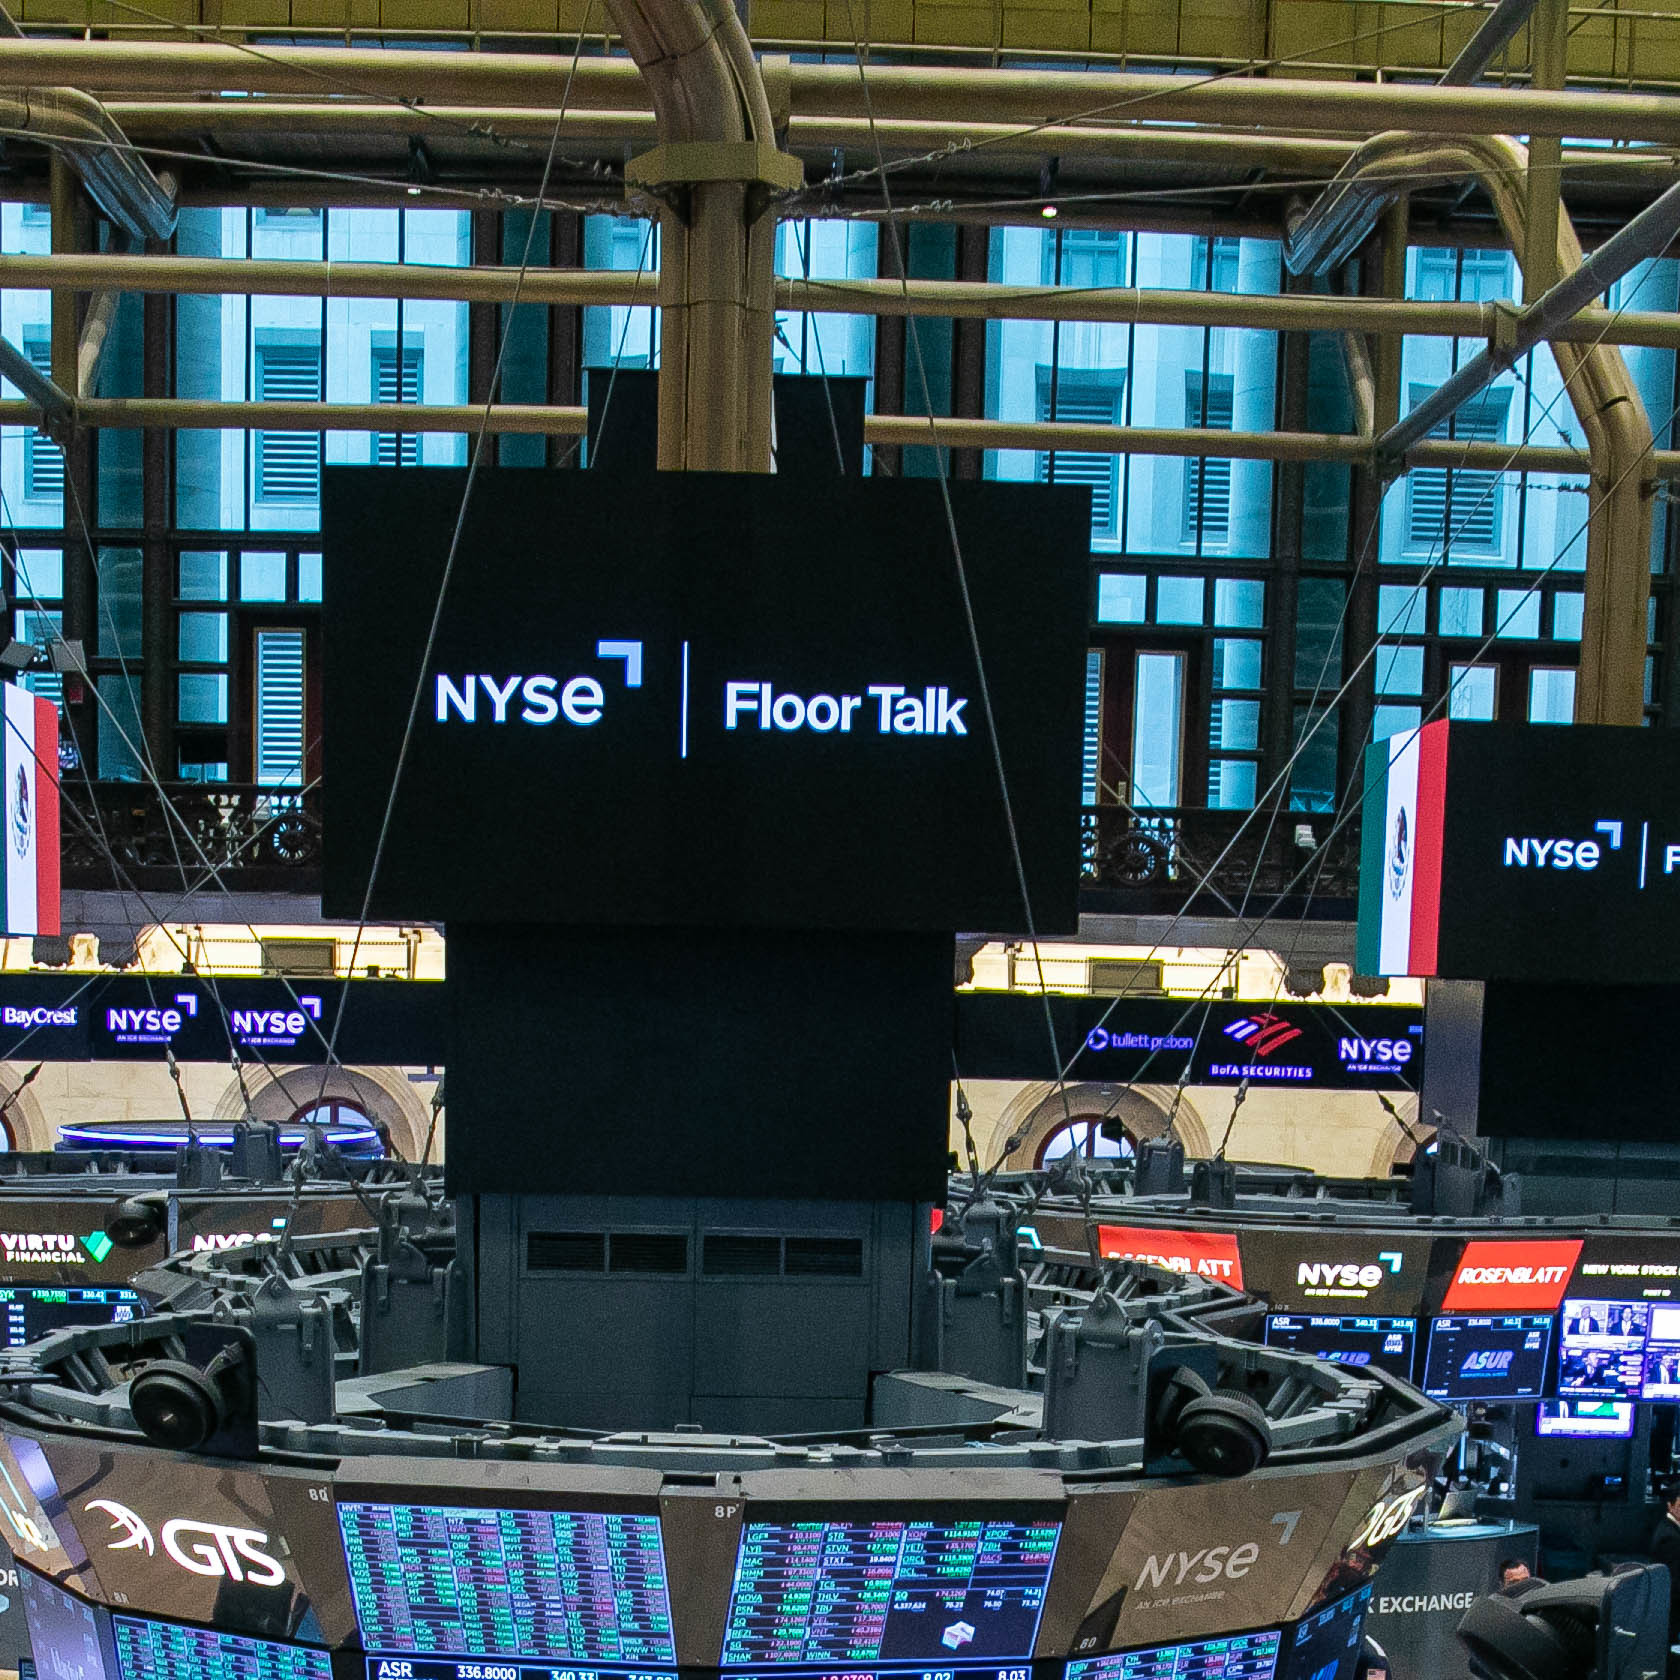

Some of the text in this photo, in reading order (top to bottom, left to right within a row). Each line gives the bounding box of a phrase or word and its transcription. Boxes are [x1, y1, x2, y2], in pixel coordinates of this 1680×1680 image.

[3, 1006, 77, 1028] BayCrest
[1112, 1032, 1148, 1048] tullett
[1242, 1066, 1312, 1078] SECURITIES
[0, 1233, 75, 1251] VIRTU
[6, 1250, 85, 1264] FINANCIAL
[1458, 1265, 1568, 1284] ROSENBLATT
[1610, 1264, 1639, 1276] YORK
[1641, 1264, 1677, 1276] STOCK
[161, 1519, 285, 1587] GTS
[1379, 1591, 1474, 1613] EXCHANGE
[378, 1661, 412, 1677] ASR
[457, 1665, 516, 1680] 336.8000
